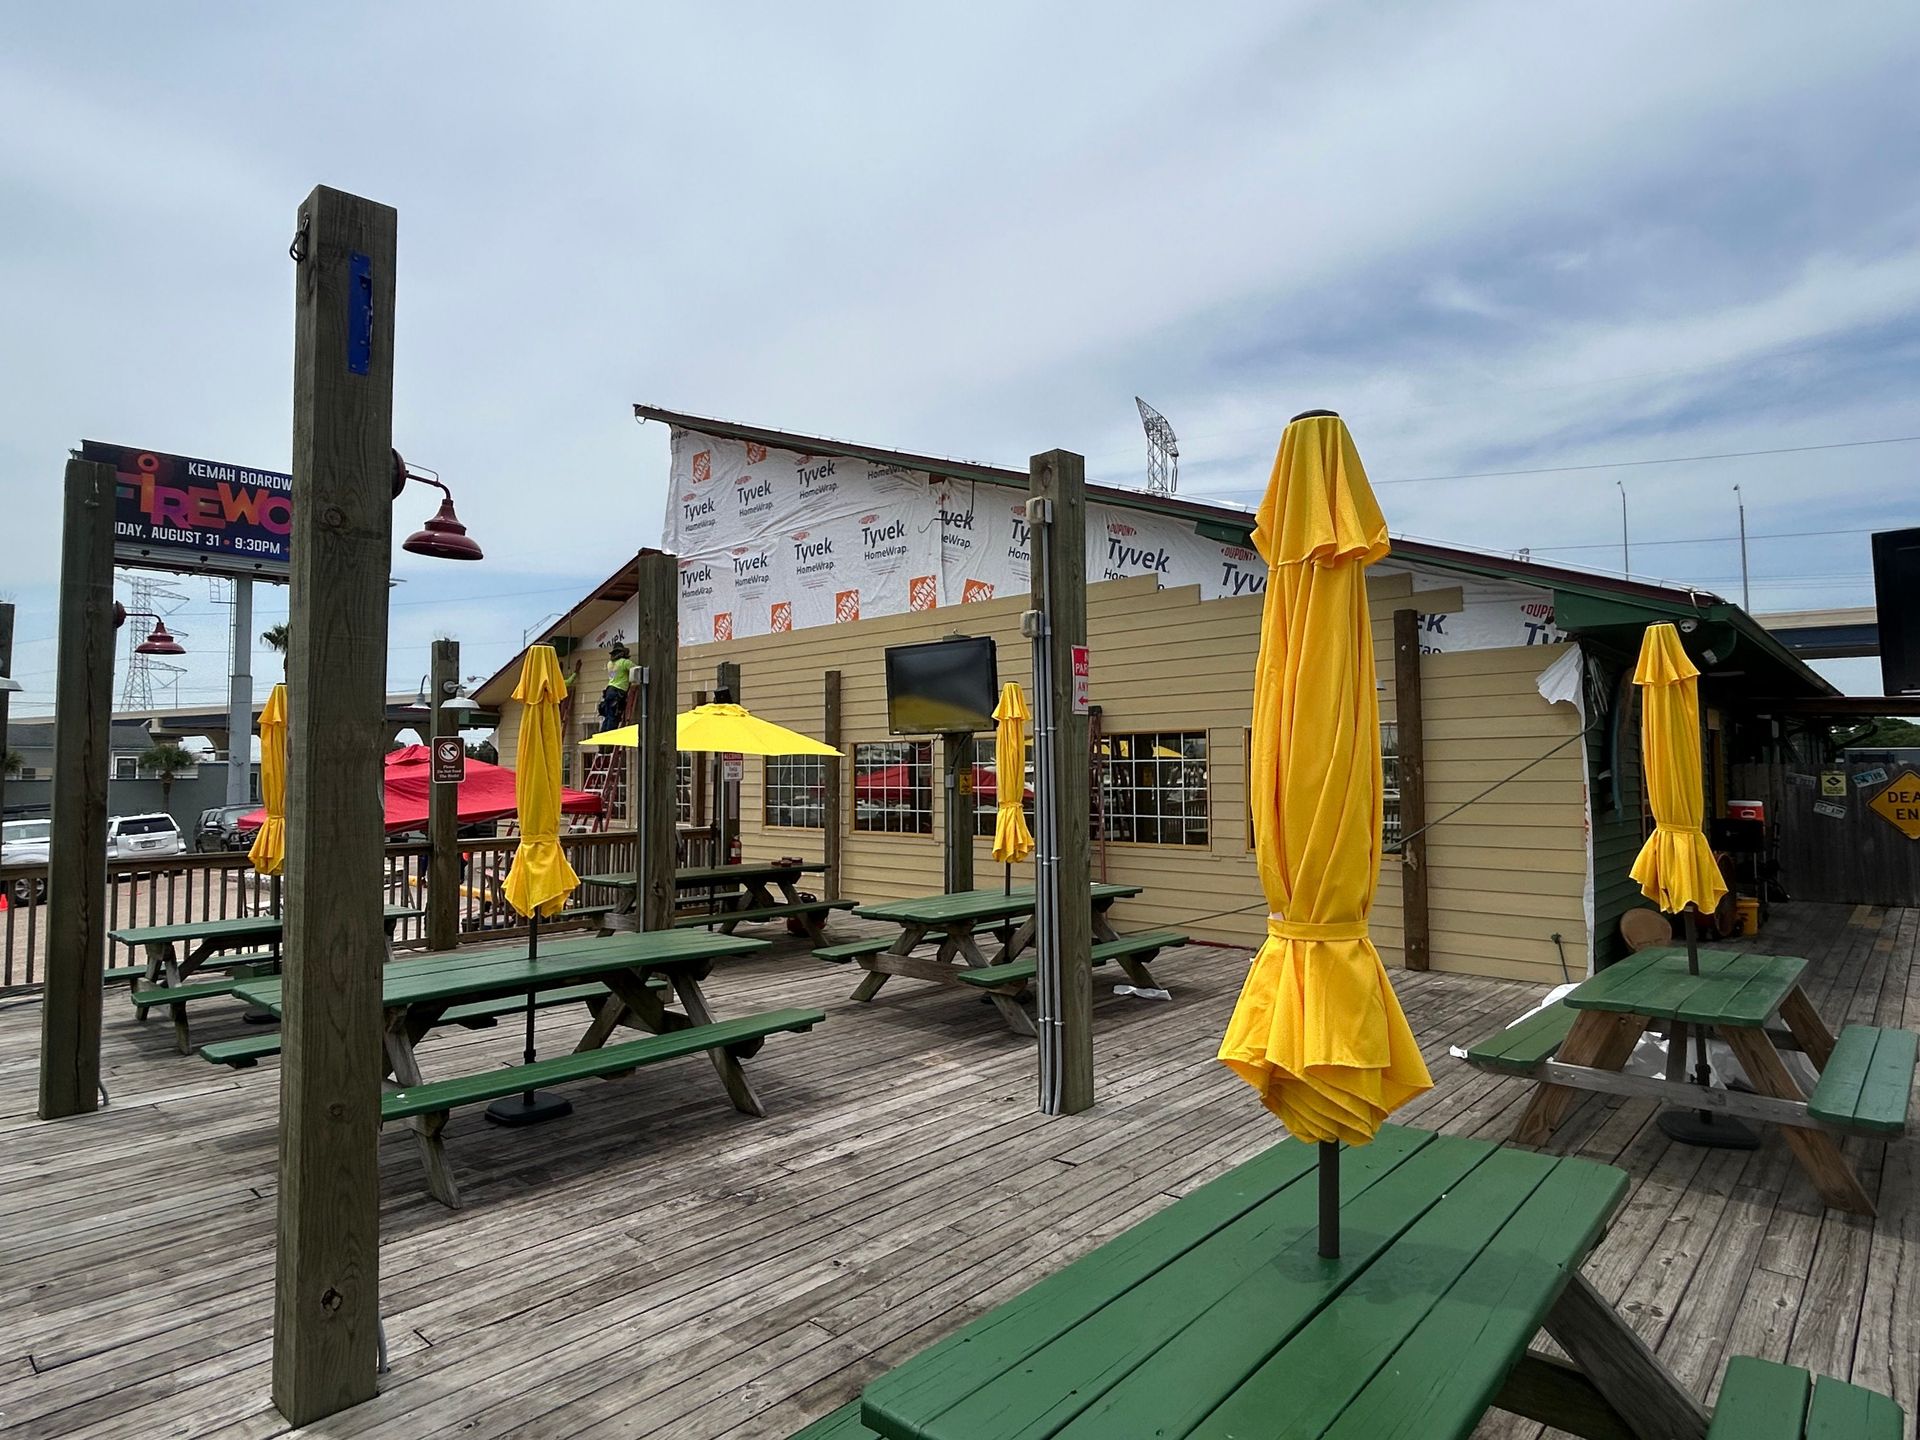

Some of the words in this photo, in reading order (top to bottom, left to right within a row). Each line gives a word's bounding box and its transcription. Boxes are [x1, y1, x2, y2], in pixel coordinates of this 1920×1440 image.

[188, 461, 236, 482] KEMAH
[240, 471, 292, 491] BOARDW
[797, 460, 835, 487] Tyvek
[738, 480, 772, 506] Tyvek
[800, 483, 837, 499] HomeWrap
[684, 497, 715, 522] Tyvek
[739, 501, 772, 517] HomeWrap
[685, 518, 714, 532] HomeWrap
[861, 519, 905, 548] Tyvek
[1012, 518, 1030, 547] Ty
[1110, 523, 1134, 536] DUPONT
[151, 526, 201, 544] AUGUST
[206, 534, 219, 546] 31
[234, 537, 280, 554] 9:30PM
[794, 537, 832, 563] Tyvek
[733, 552, 767, 576] Tyvek
[864, 545, 906, 560] HomeWrap
[1107, 537, 1170, 573] Tyvek
[680, 565, 712, 587] Tyvek
[796, 561, 834, 575] HomeWrap
[1222, 562, 1267, 596] Tyv
[682, 587, 712, 599] HomeWrap
[735, 574, 769, 588] HomeWrap
[1896, 808, 1919, 820] EN
